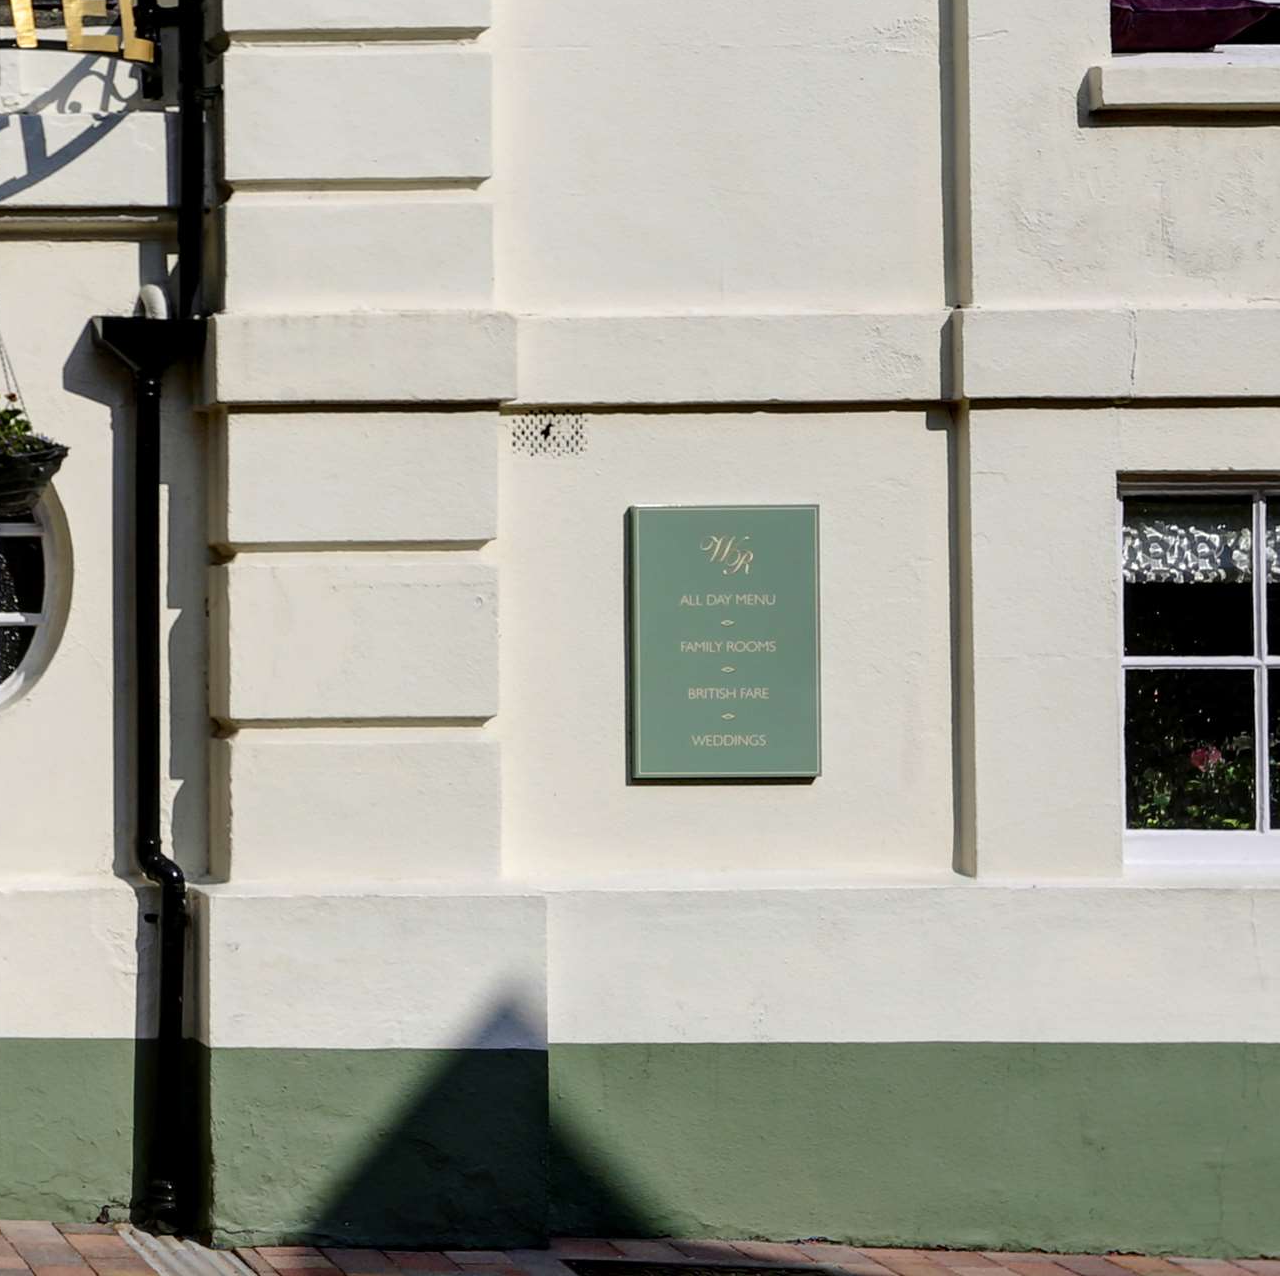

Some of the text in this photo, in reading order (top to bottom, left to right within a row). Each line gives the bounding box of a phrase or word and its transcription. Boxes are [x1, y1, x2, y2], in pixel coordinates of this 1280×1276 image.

[680, 594, 776, 606] ALL DAY MENU
[680, 641, 777, 653] FAMILY ROOMS
[688, 687, 769, 699] BRITISH FARE
[690, 734, 767, 746] WEDDINGS
